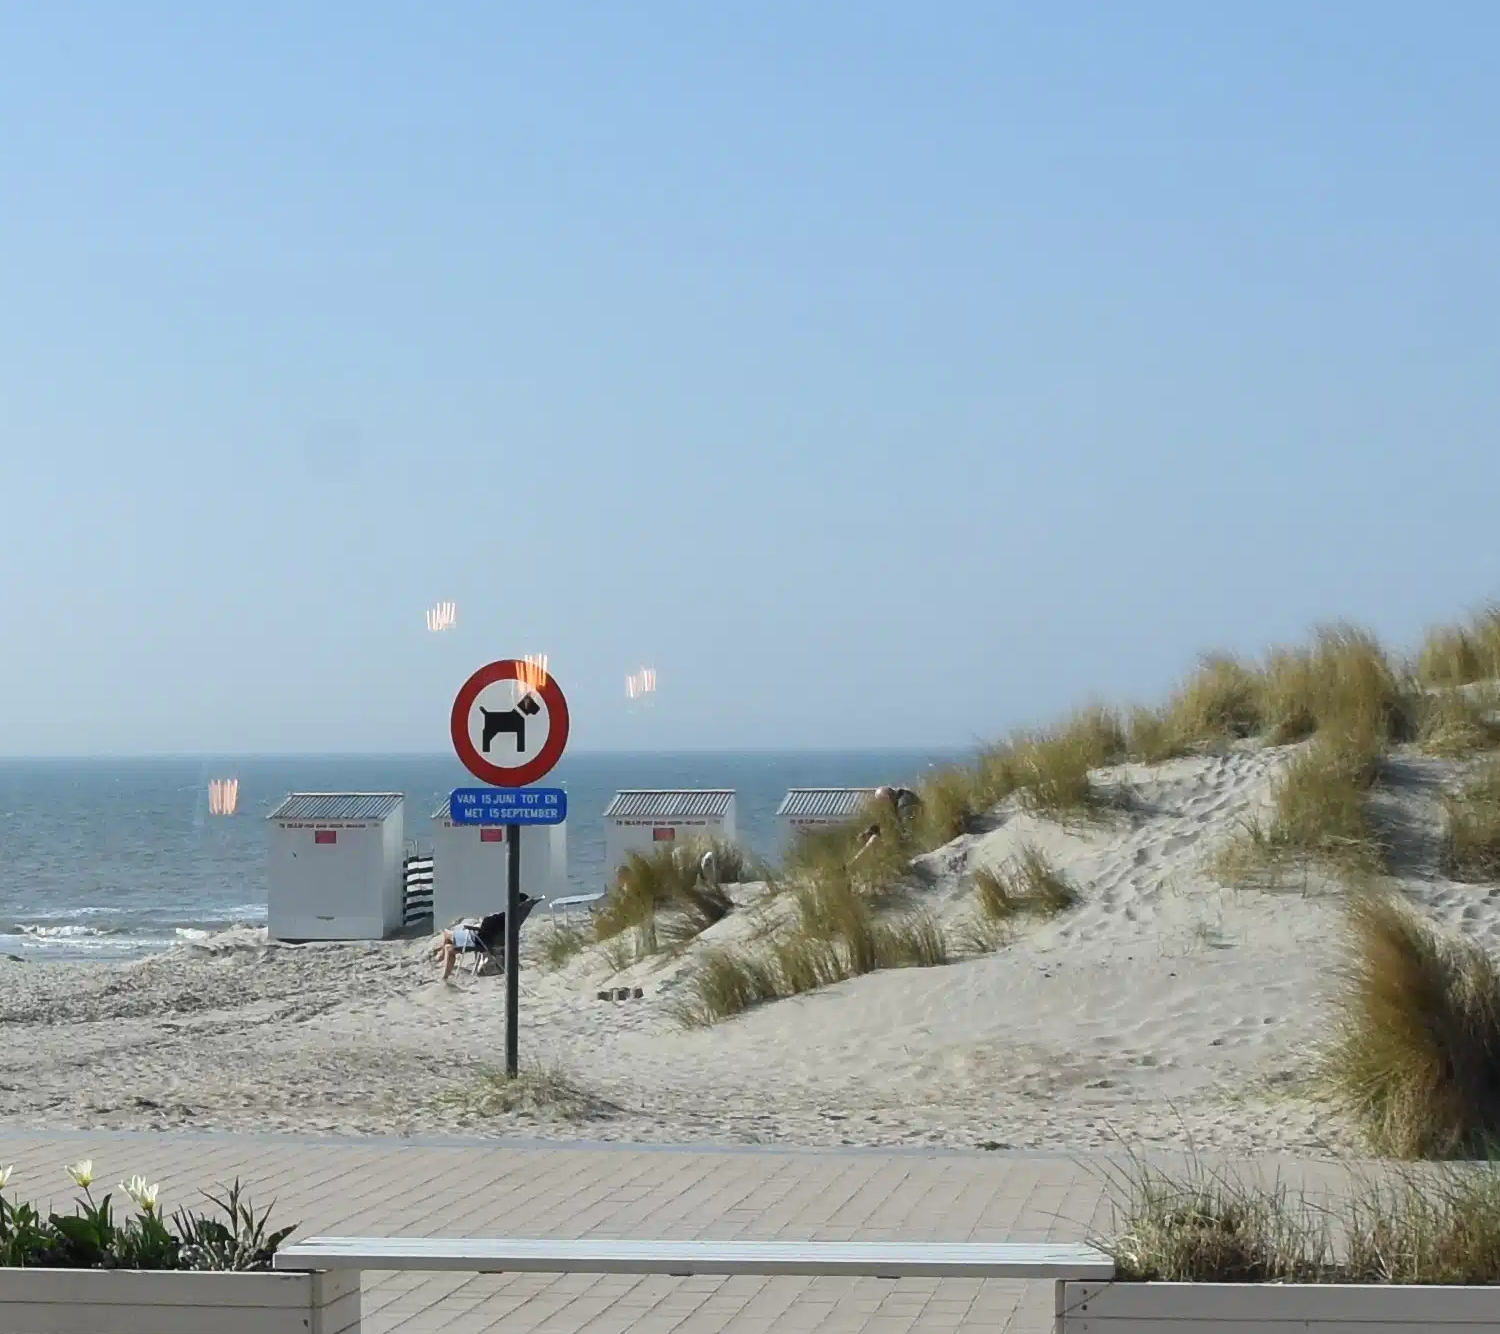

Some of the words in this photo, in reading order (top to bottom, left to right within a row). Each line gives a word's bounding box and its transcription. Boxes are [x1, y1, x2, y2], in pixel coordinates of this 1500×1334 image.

[457, 794, 476, 804] VAN
[481, 794, 492, 804] 15
[493, 794, 516, 804] JUNI
[521, 794, 540, 804] TOT
[544, 794, 558, 804] EN
[464, 808, 484, 818] MET
[489, 808, 500, 818] 15
[500, 808, 558, 819] SEPTEMBER
